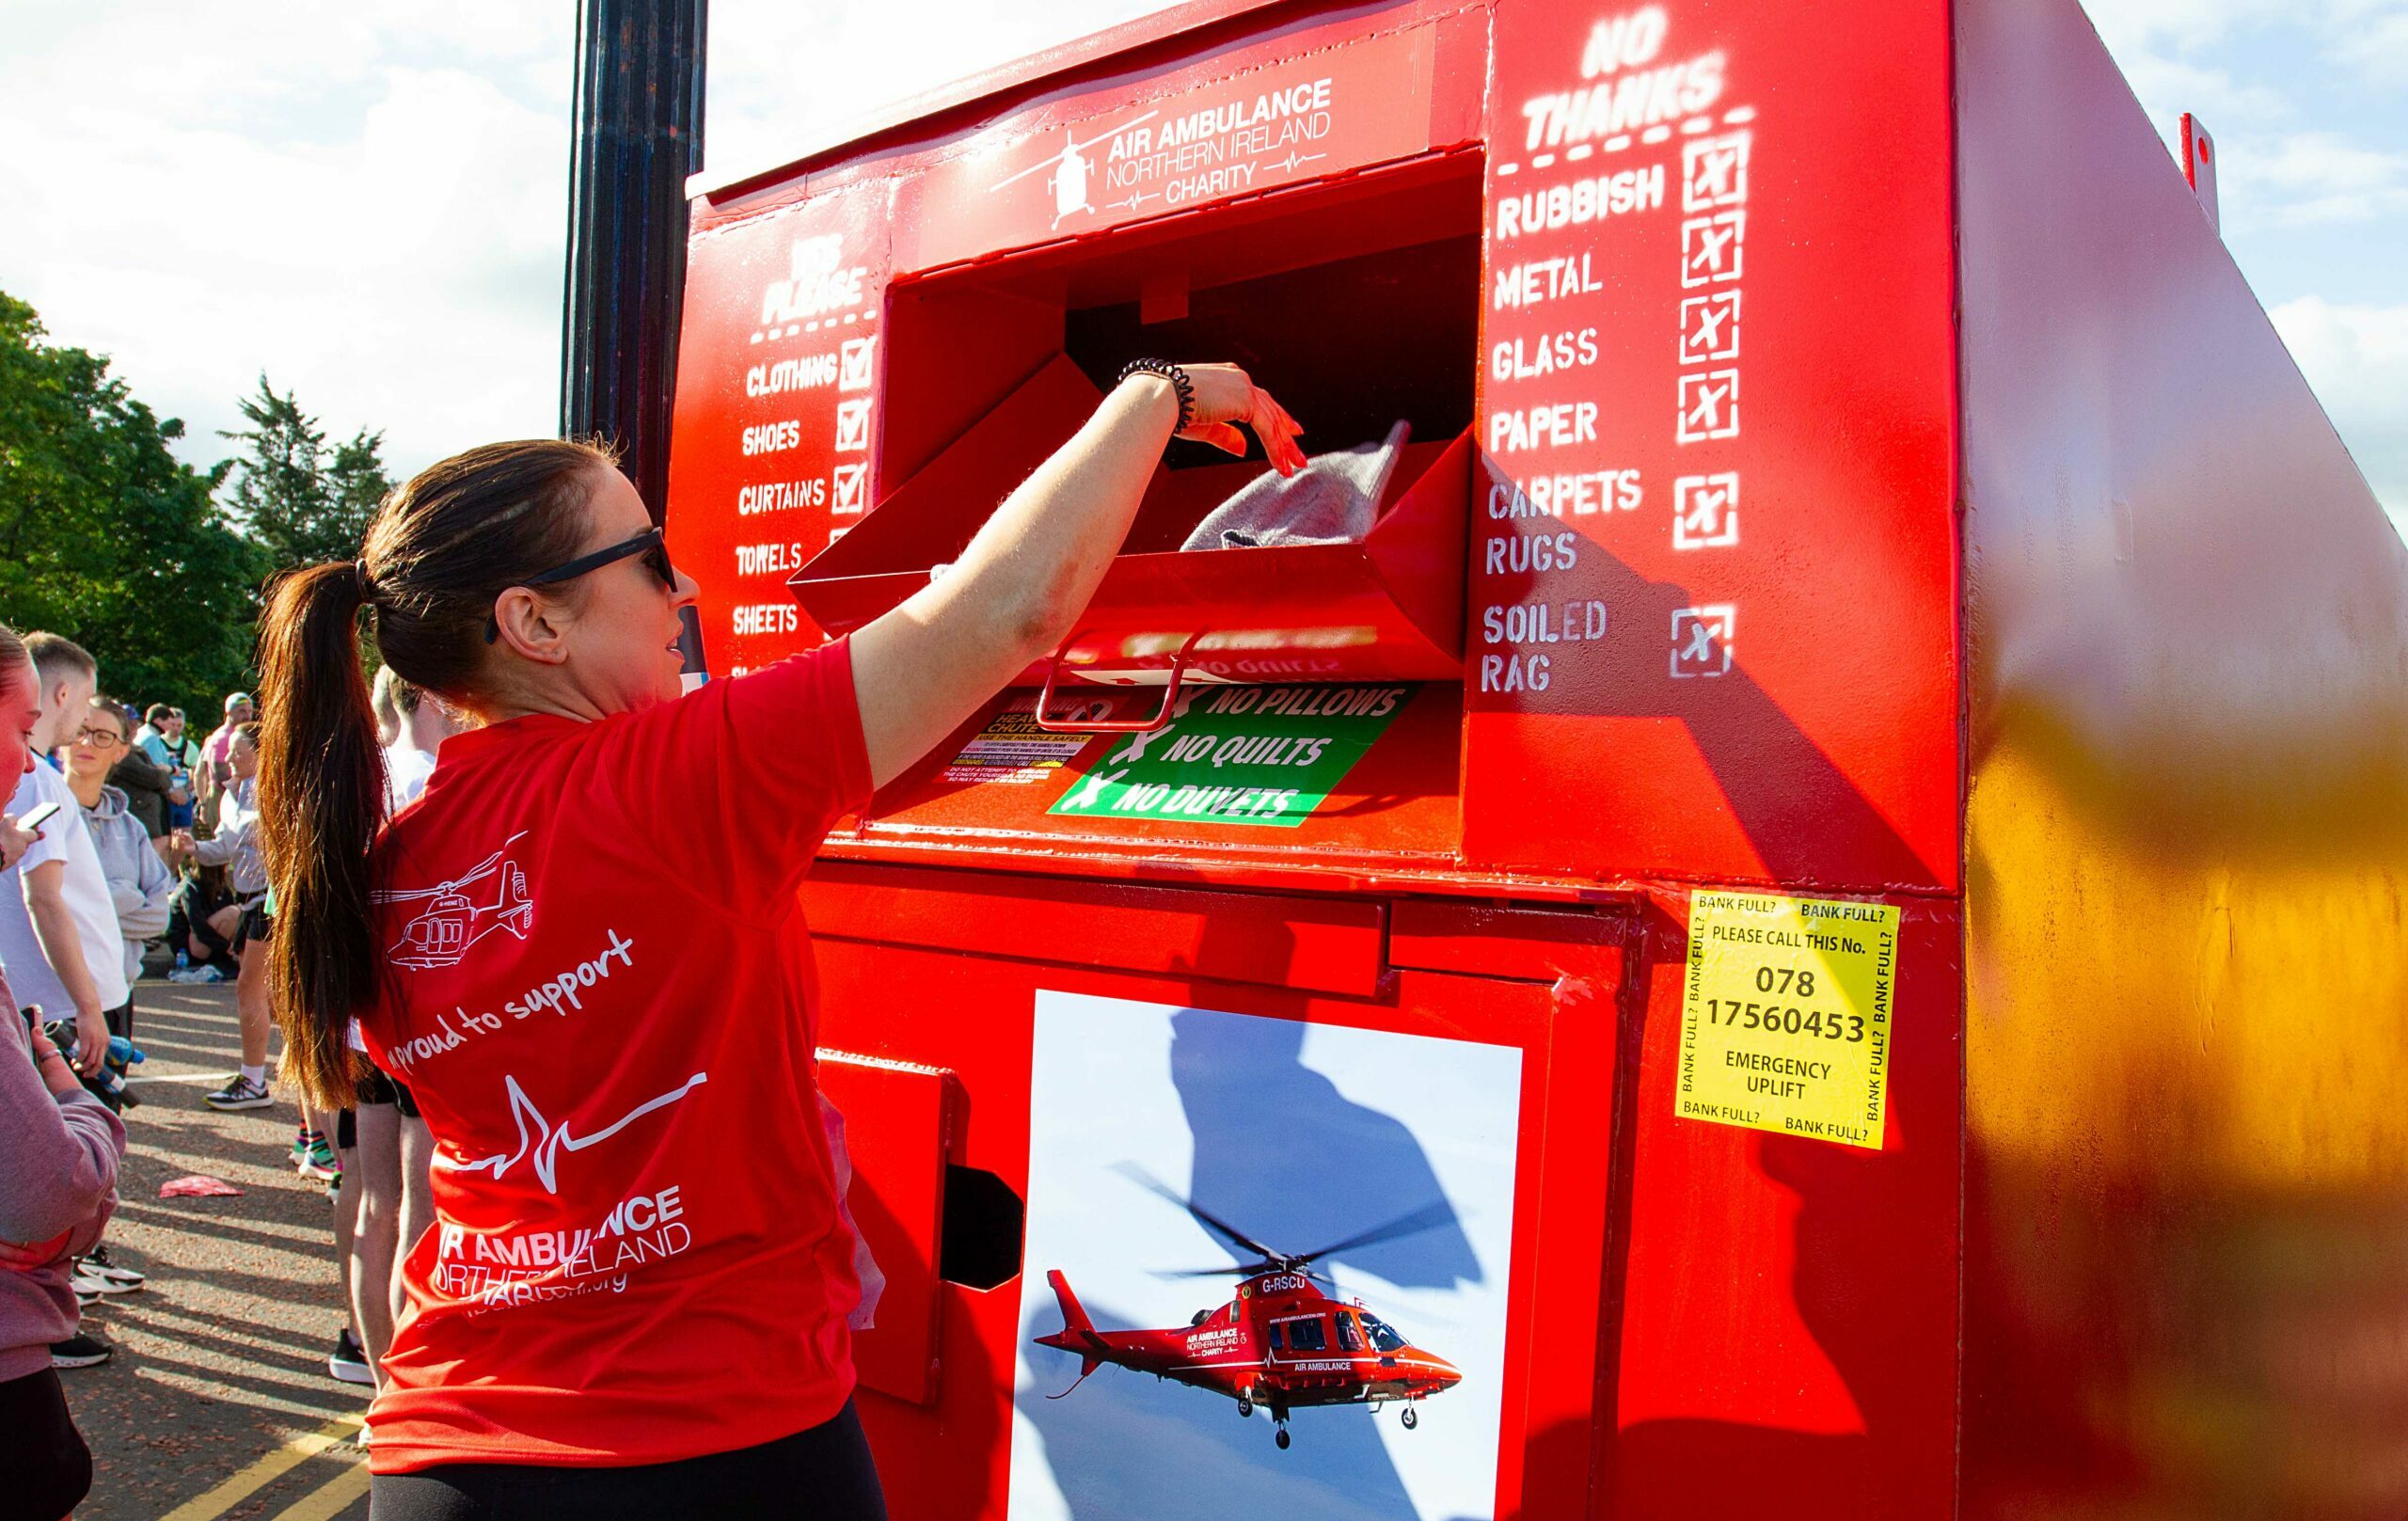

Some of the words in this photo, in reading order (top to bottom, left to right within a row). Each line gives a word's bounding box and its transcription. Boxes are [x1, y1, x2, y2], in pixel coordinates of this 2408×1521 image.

[1580, 6, 1671, 79] NO
[1522, 50, 1728, 151] THANKS
[1106, 127, 1151, 163] AIR
[1157, 78, 1332, 151] AMBULANCE
[1106, 142, 1224, 191] NORTHERN
[1231, 111, 1331, 154] IRELAND
[1165, 162, 1258, 204] CHARITY
[1495, 165, 1664, 241] RUBBISH
[1494, 252, 1603, 311] METAL
[1492, 327, 1598, 380] GLASS
[747, 352, 838, 397] CLOTHING
[742, 420, 800, 456] SHOES
[1490, 402, 1598, 453] PAPER
[738, 479, 825, 515] CURTAINS
[1488, 468, 1643, 520] CARPETS
[736, 543, 801, 576] TOWELS
[1486, 532, 1576, 575] RUGS
[733, 604, 798, 635] SHEETS
[1483, 600, 1607, 644] SOILED
[1481, 655, 1550, 692] RAG
[996, 714, 1043, 723] HEAV
[1205, 688, 1262, 715] NO
[1254, 689, 1406, 717] PILLOWS
[988, 724, 1038, 733] CHUTE
[1160, 735, 1218, 763] NO
[1212, 737, 1332, 768] QUILTS
[1111, 783, 1171, 813] NO
[1159, 784, 1300, 818] DUVETS
[1699, 895, 1735, 911] BANK
[1737, 898, 1776, 913] FULL?
[1801, 904, 1840, 919] BANK
[1844, 907, 1885, 923] FULL?
[1691, 916, 1705, 959] FULL?
[1712, 926, 1763, 943] PLEASE
[1766, 930, 1801, 948] CALL
[1806, 934, 1838, 951] THIS
[1841, 938, 1866, 955] No.
[1877, 931, 1893, 977] FULL?
[456, 1006, 502, 1035] to
[504, 928, 634, 1020] support
[1689, 960, 1703, 1002] BANK
[1756, 966, 1815, 997] 078
[1707, 999, 1864, 1043] 17560453
[1874, 982, 1888, 1023] BANK
[1685, 1006, 1699, 1049] FULL?
[1683, 1051, 1695, 1092] BANK
[1725, 1050, 1831, 1080] EMERGENCY
[1870, 1030, 1884, 1075] FULL?
[1747, 1076, 1806, 1100] UPLIFT
[1867, 1078, 1880, 1121] BANK
[1684, 1101, 1719, 1117] BANK
[1721, 1106, 1760, 1124] FULL?
[1785, 1117, 1824, 1134] BANK
[1827, 1124, 1868, 1142] FULL?
[1262, 1276, 1306, 1292] G-RSCU
[1187, 1334, 1198, 1343] AIR
[1198, 1327, 1238, 1342] AMBULANCE
[1187, 1340, 1215, 1351] NORTHERN
[1215, 1337, 1239, 1347] IRELAND
[1201, 1348, 1224, 1357] CHARITY
[1294, 1363, 1307, 1371] AIR
[1307, 1362, 1352, 1371] AMBULANCE
